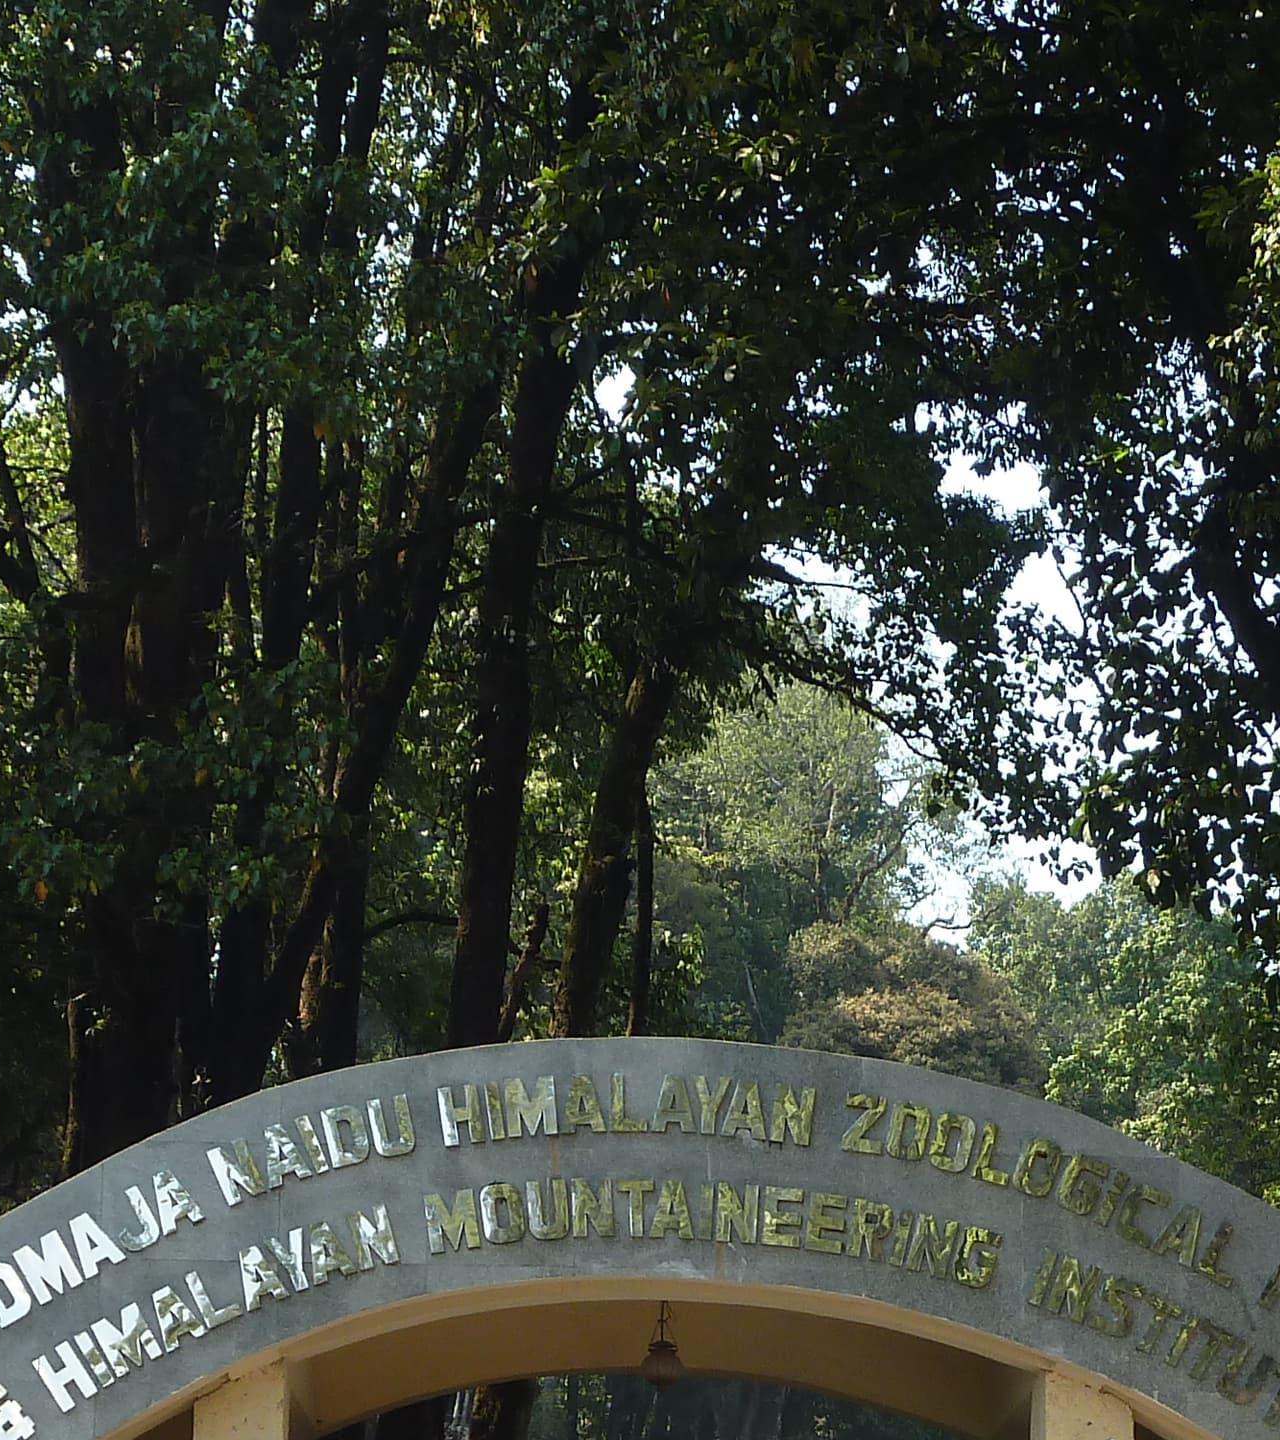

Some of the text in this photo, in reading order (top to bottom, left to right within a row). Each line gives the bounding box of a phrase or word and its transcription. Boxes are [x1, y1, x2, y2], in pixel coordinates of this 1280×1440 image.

[206, 1093, 417, 1207] NAIDU
[436, 1071, 817, 1148] HIMALAYAN
[840, 1091, 1234, 1289] ZOOLOGICAL
[31, 1203, 401, 1414] HIMALAYAN
[424, 1176, 1004, 1290] MOUNTAINEERING
